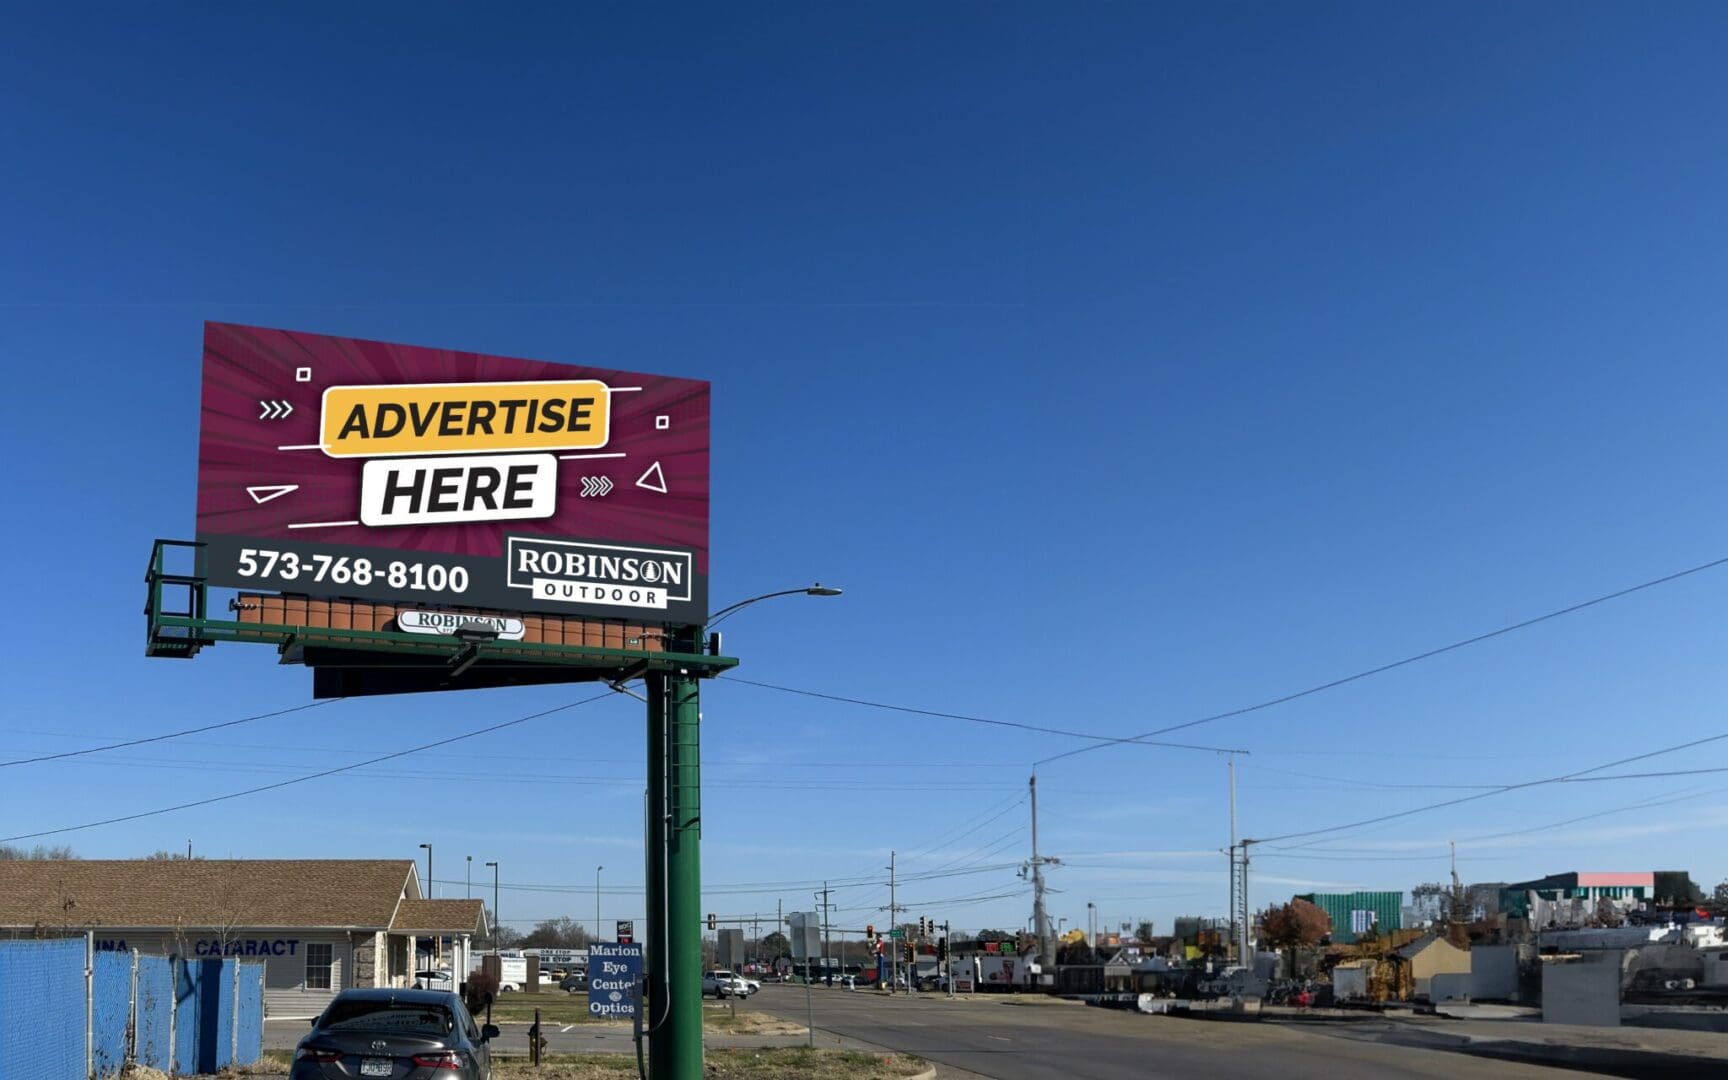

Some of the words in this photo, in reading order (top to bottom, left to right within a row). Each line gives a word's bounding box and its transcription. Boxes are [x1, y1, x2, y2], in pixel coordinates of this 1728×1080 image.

[338, 397, 595, 440] ADVERTISE
[381, 465, 539, 515] HERE
[237, 548, 470, 593] 573-768-8100
[517, 549, 683, 585] ROBINSON
[544, 583, 656, 604] OUTDOOR
[194, 940, 300, 956] CATARACT
[590, 945, 641, 956] Marion
[602, 961, 628, 975] Eye
[590, 1002, 635, 1014] Optica
